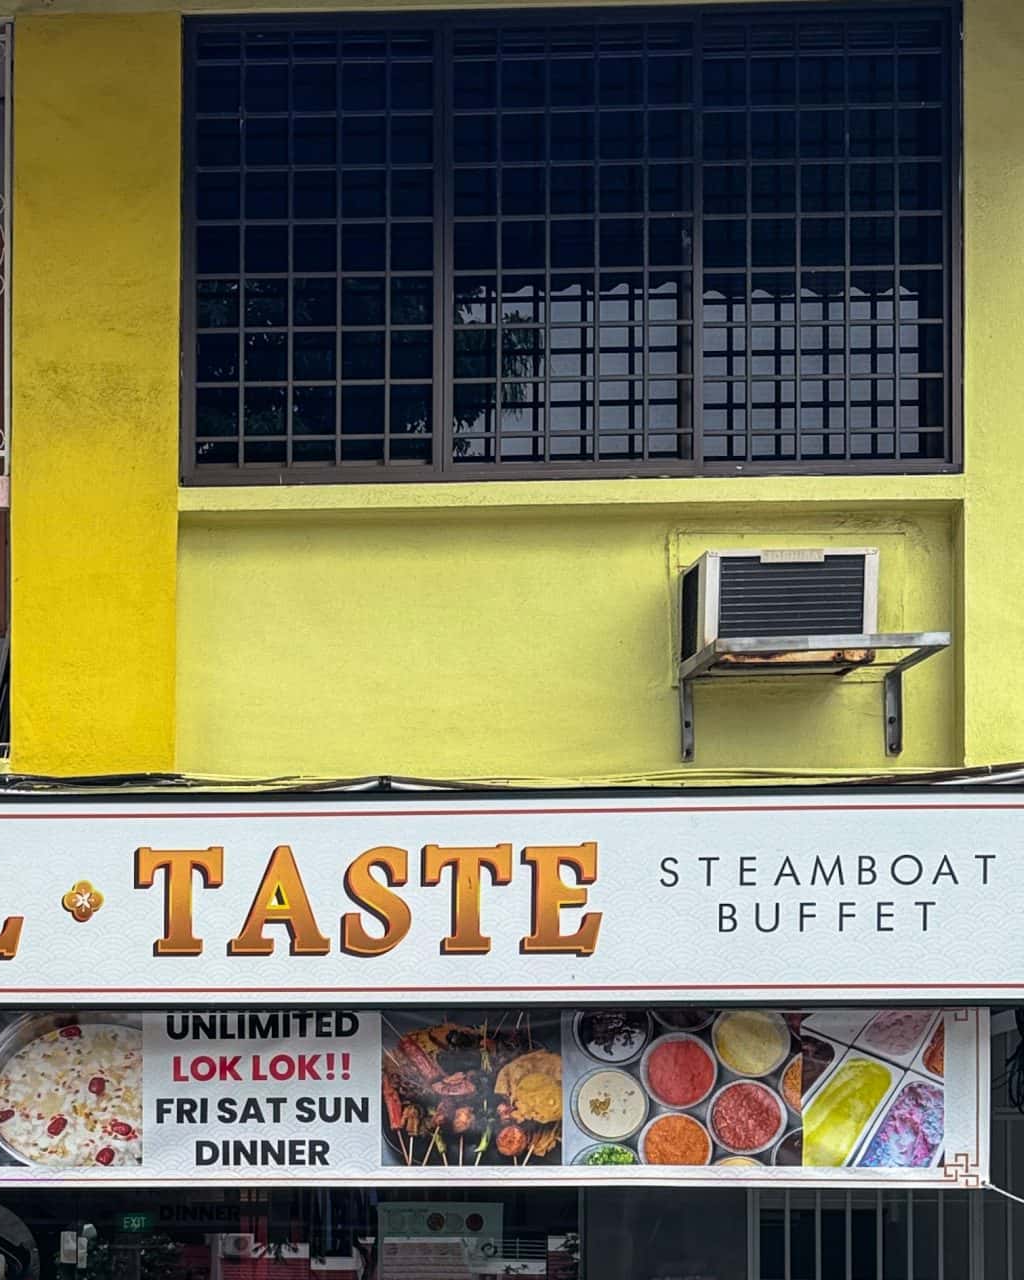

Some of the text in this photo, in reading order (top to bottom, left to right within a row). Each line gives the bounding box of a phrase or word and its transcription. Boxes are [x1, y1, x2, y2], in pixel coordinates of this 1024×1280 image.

[660, 854, 997, 888] STEAMBOAT
[134, 841, 603, 957] TASTE
[719, 901, 936, 933] BUFFET
[166, 1011, 359, 1040] UNLIMITED
[172, 1053, 351, 1082] LOK LOK!!
[156, 1097, 369, 1124] FRI SAT SUN
[195, 1139, 330, 1166] DINNER
[123, 1216, 146, 1229] EXIT
